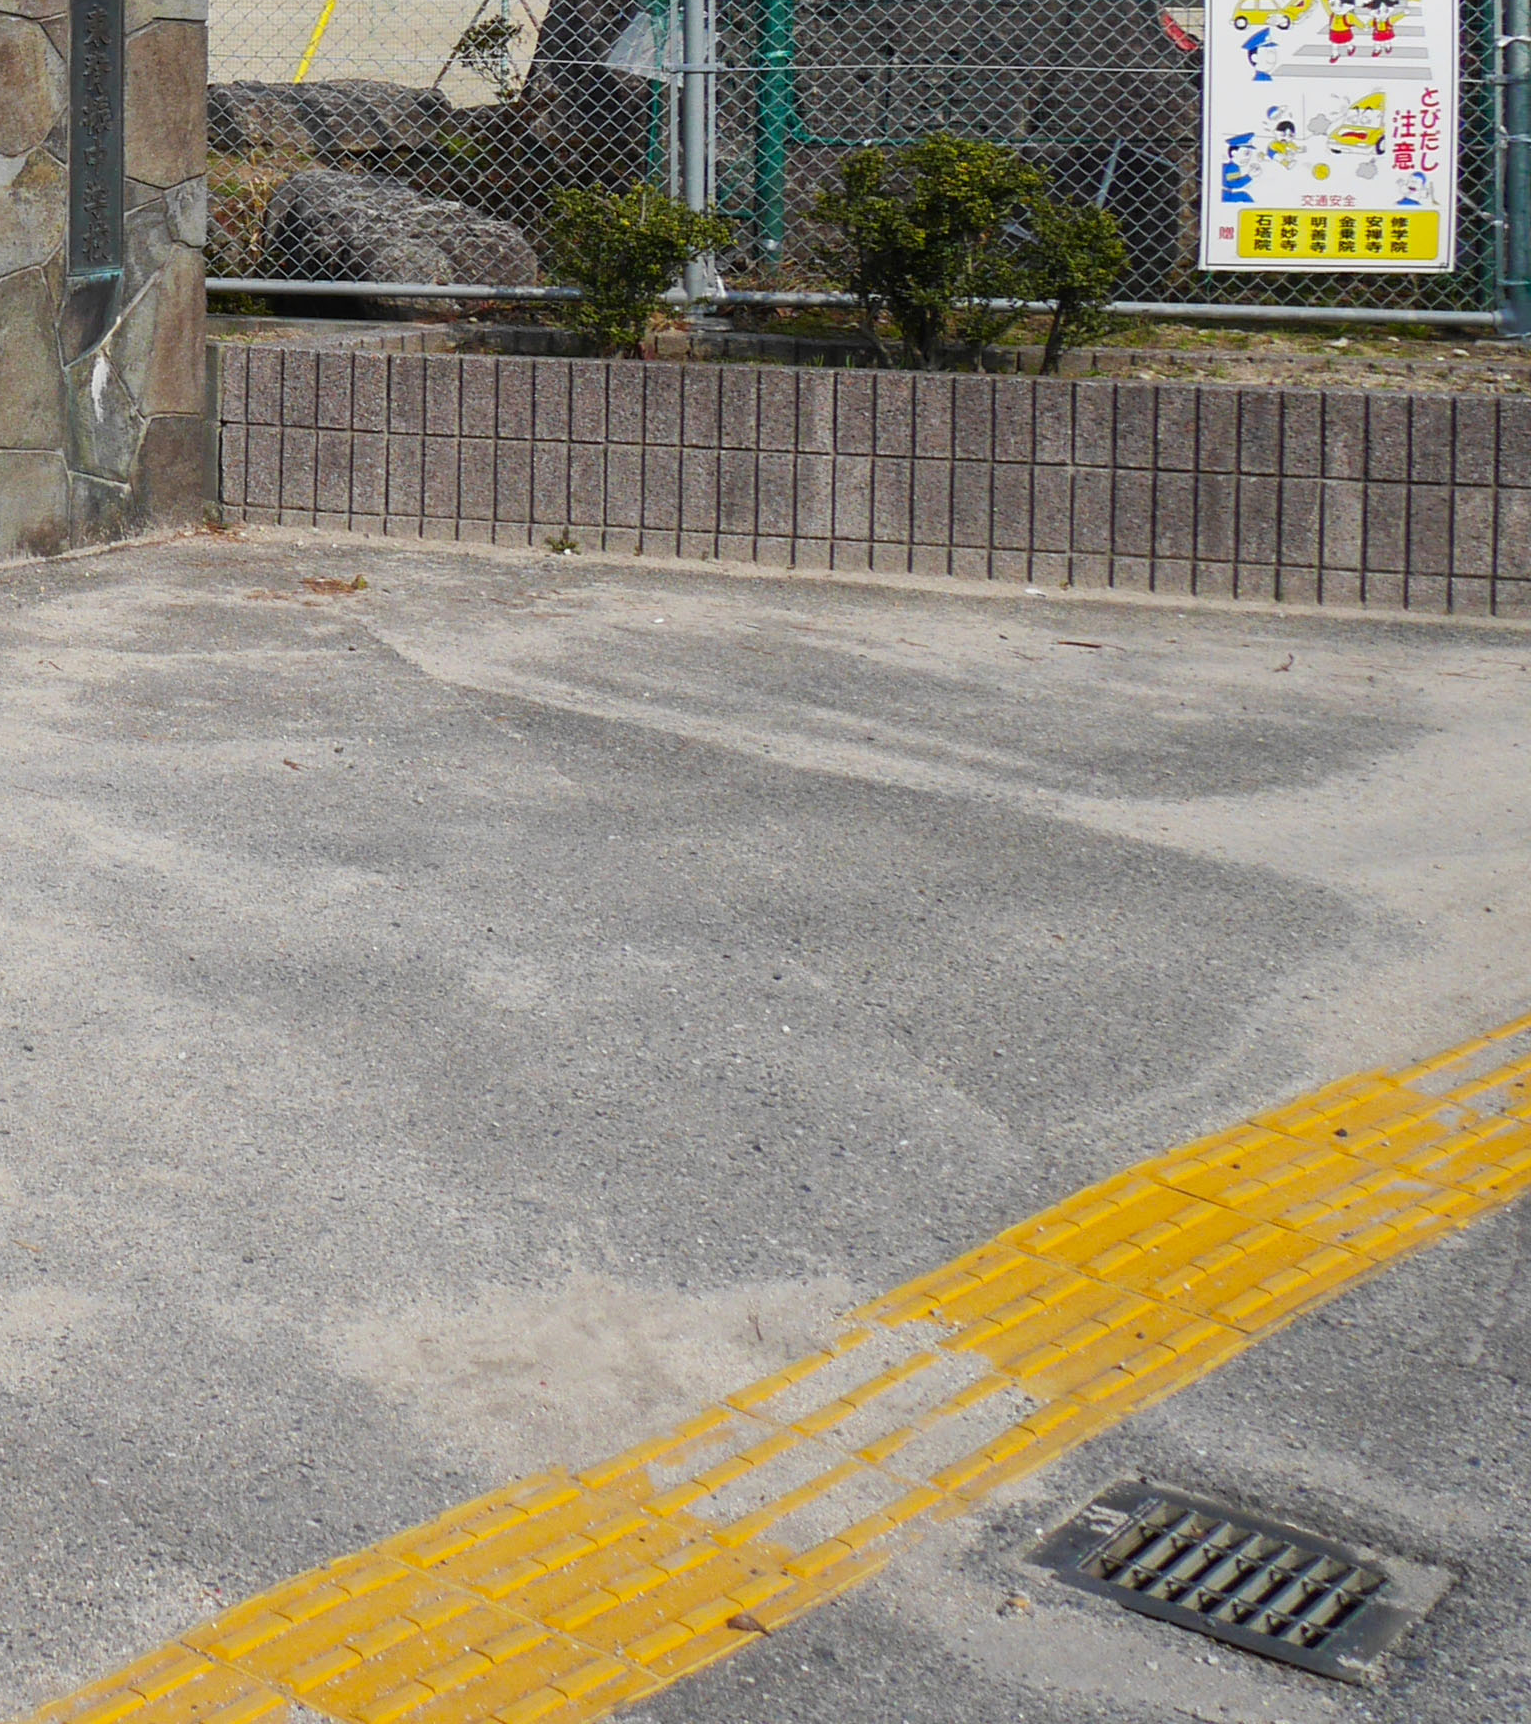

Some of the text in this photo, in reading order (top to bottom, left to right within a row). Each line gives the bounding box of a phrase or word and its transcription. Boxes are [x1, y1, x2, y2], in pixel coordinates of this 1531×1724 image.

[1391, 109, 1417, 170] 注意
[1420, 86, 1440, 173] とびだし
[1300, 194, 1357, 207] 交通安全
[1253, 214, 1273, 252] 石塔院
[1280, 215, 1299, 252] 東妙寺
[1310, 216, 1328, 253] 明善寺
[1390, 216, 1409, 253] 修学院
